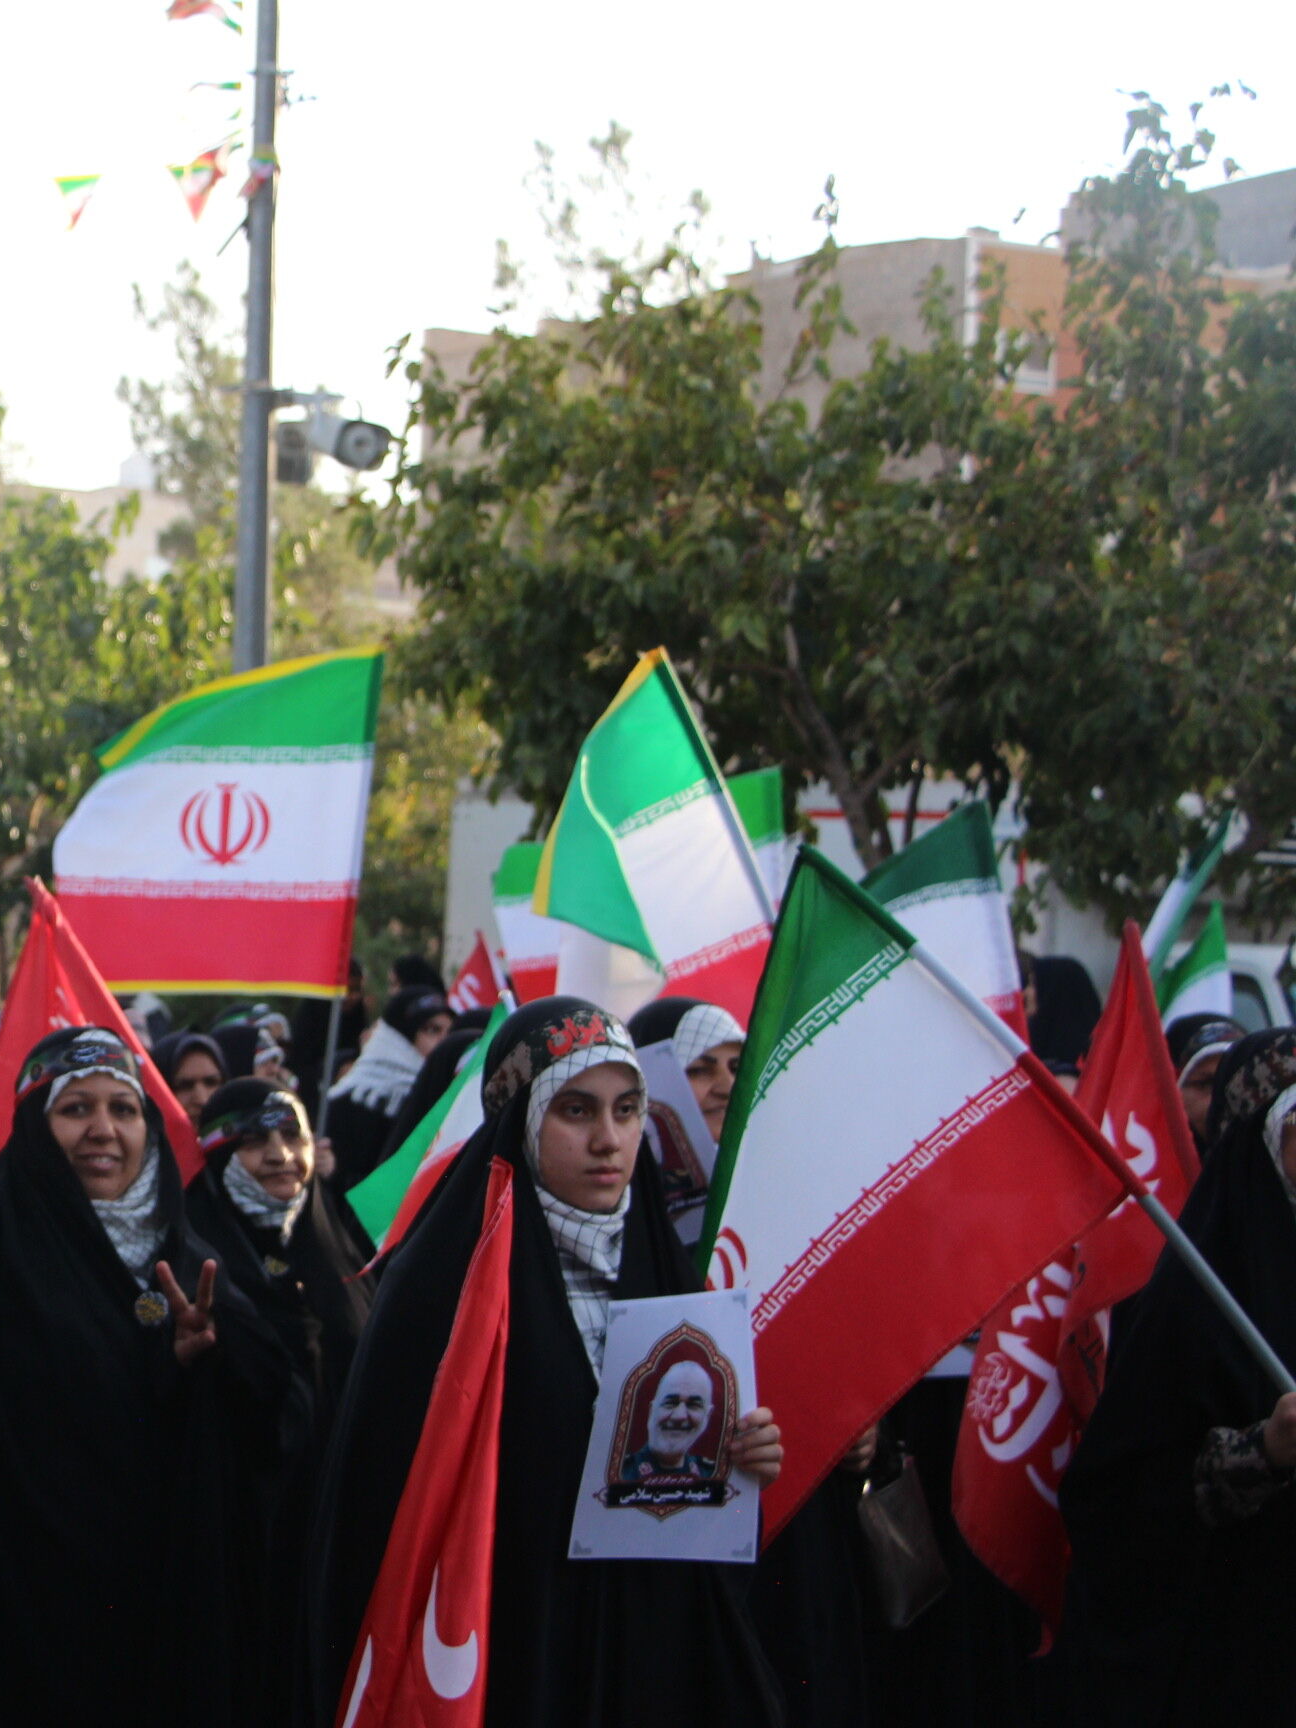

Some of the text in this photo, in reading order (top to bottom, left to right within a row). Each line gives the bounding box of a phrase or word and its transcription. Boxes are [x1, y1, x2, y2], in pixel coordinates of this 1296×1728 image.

[547, 1014, 606, 1056] ایران
[619, 1486, 711, 1504] شهید حسین سلامی
